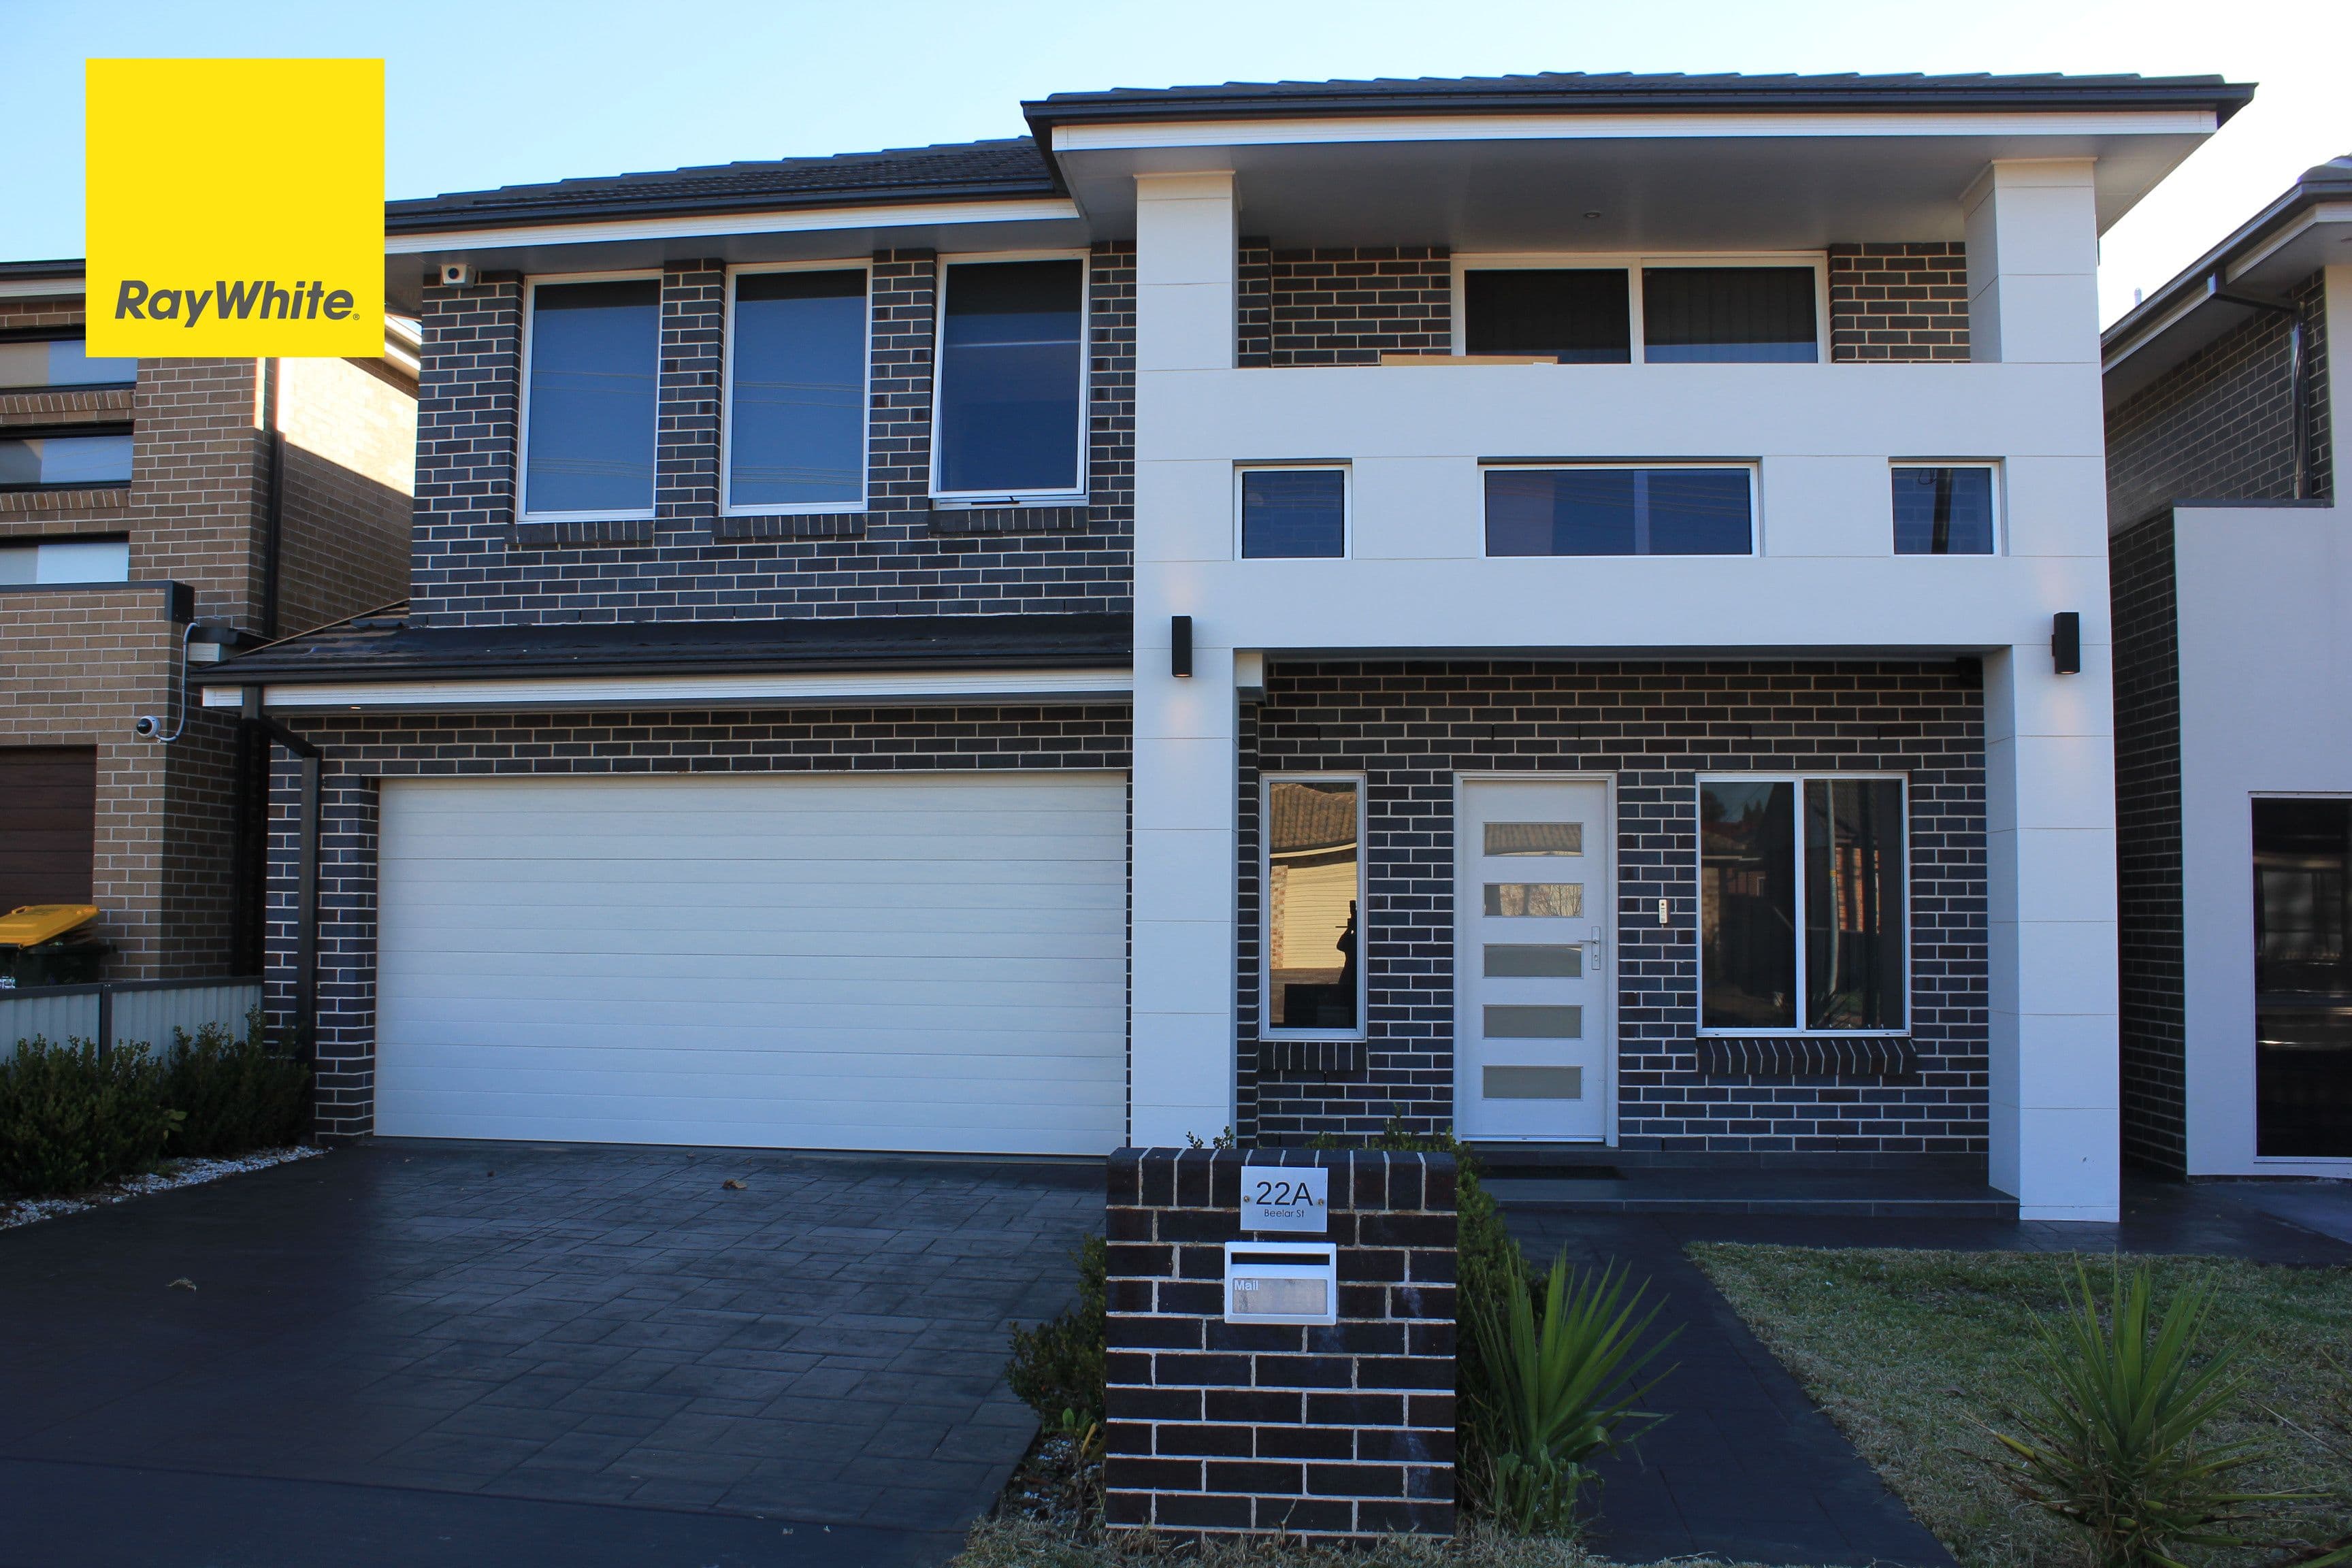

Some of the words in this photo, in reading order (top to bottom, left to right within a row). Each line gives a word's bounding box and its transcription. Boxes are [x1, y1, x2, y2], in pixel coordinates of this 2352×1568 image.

[1256, 1181, 1313, 1206] 22A
[1264, 1209, 1294, 1218] Beelar
[1296, 1209, 1305, 1218] St
[1234, 1279, 1259, 1291] Mail
